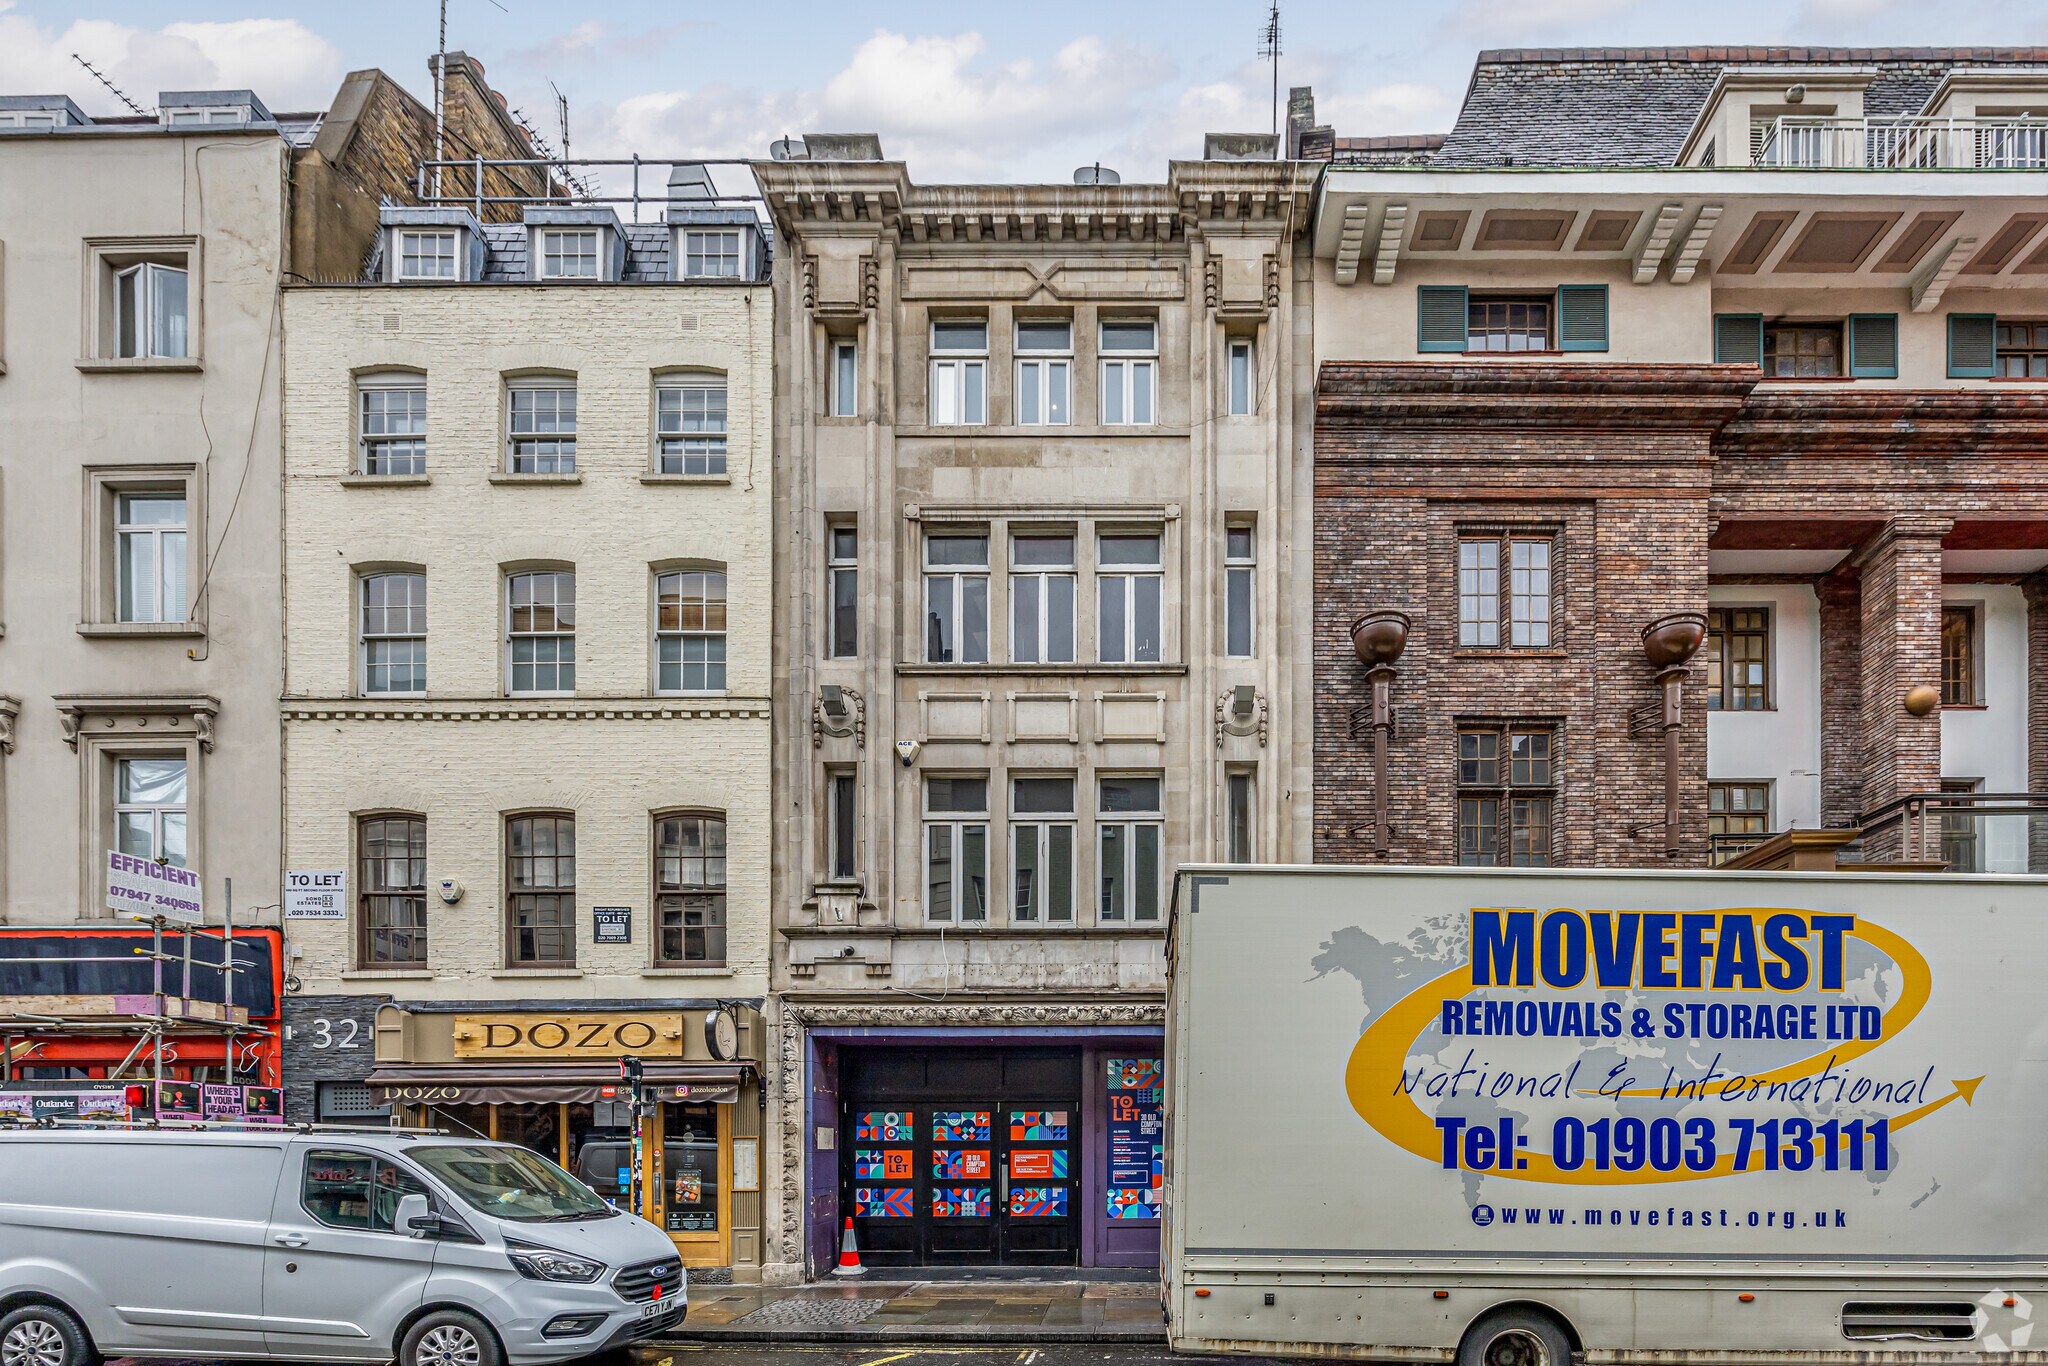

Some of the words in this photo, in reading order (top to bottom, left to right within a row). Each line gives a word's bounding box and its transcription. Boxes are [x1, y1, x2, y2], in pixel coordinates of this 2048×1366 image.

[111, 853, 198, 888] EFFICIENT
[290, 875, 310, 886] TO
[315, 875, 341, 886] LET
[110, 886, 151, 902] 07947
[1471, 909, 1856, 991] MOVEFAST
[1442, 1000, 1622, 1038] REMOVALS
[1631, 1007, 1655, 1038] &
[1664, 1004, 1816, 1040] STORAGE
[1826, 1005, 1881, 1041] LTD
[312, 1018, 359, 1048] 32
[481, 1022, 657, 1049] DOZO
[1393, 1049, 1581, 1099] National
[1600, 1057, 1635, 1101] &
[1660, 1053, 1935, 1103] International
[206, 1086, 239, 1096] WHERE'S
[383, 1087, 460, 1098] DOZO
[35, 1100, 75, 1108] Outlander
[82, 1100, 121, 1108] Outlander
[213, 1096, 233, 1105] YOUR
[1111, 1095, 1133, 1108] TO
[208, 1105, 227, 1113] HEAD
[228, 1106, 241, 1114] AT?
[1113, 1109, 1140, 1121] LET
[1435, 1117, 1528, 1169] Tel:
[1552, 1117, 1716, 1171] 01903
[1728, 1117, 1889, 1171] 713111
[888, 1155, 903, 1163] TO
[889, 1164, 908, 1173] LET
[1501, 1207, 1847, 1230] www.movefast.org.uk
[644, 1301, 660, 1317] CE71
